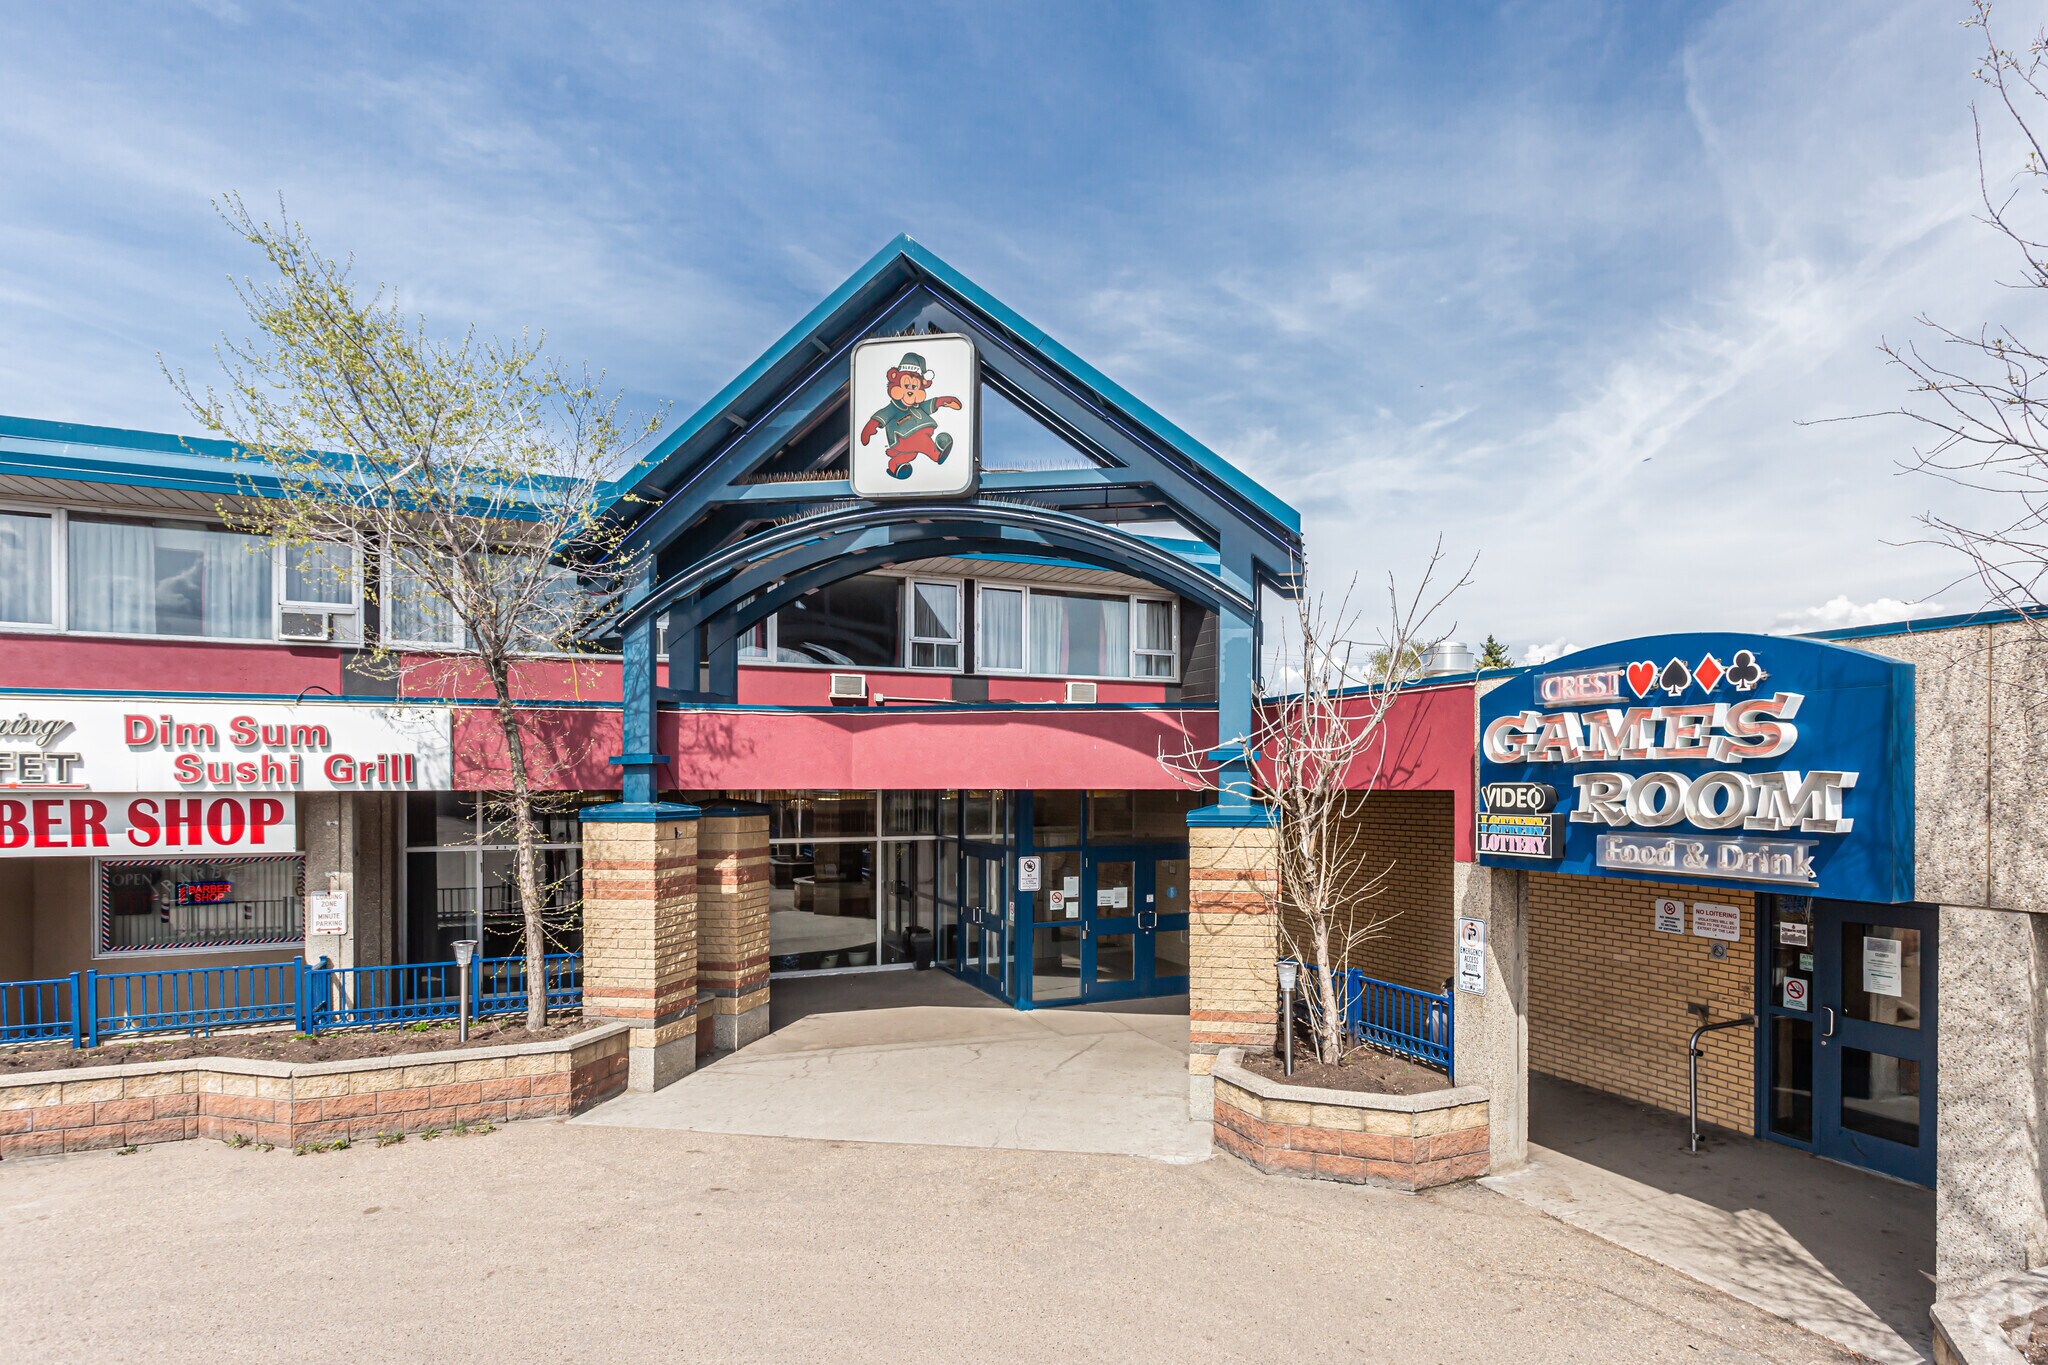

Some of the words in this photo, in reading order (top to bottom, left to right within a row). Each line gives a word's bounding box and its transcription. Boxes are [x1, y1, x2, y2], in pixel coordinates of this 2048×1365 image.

[1541, 671, 1620, 700] CREST
[124, 714, 215, 746] Dim
[229, 715, 328, 747] Sum
[1483, 692, 1804, 763] GAMES
[174, 753, 300, 784] Sushi
[324, 753, 414, 784] Grill
[1481, 785, 1546, 810] VIDEO
[1569, 771, 1859, 833] ROOM
[0, 799, 109, 848] BER
[128, 798, 284, 847] SHOP
[1481, 834, 1547, 854] LOTTERY
[1605, 837, 1675, 867] Food
[1683, 842, 1709, 869] &
[1717, 843, 1817, 878] Drink
[112, 873, 152, 887] OPEN
[188, 884, 232, 894] BARBER
[194, 893, 225, 902] SHOP
[1706, 910, 1737, 919] LOITERING
[1461, 947, 1482, 956] EMERGENCY
[1464, 956, 1478, 964] ACCESS
